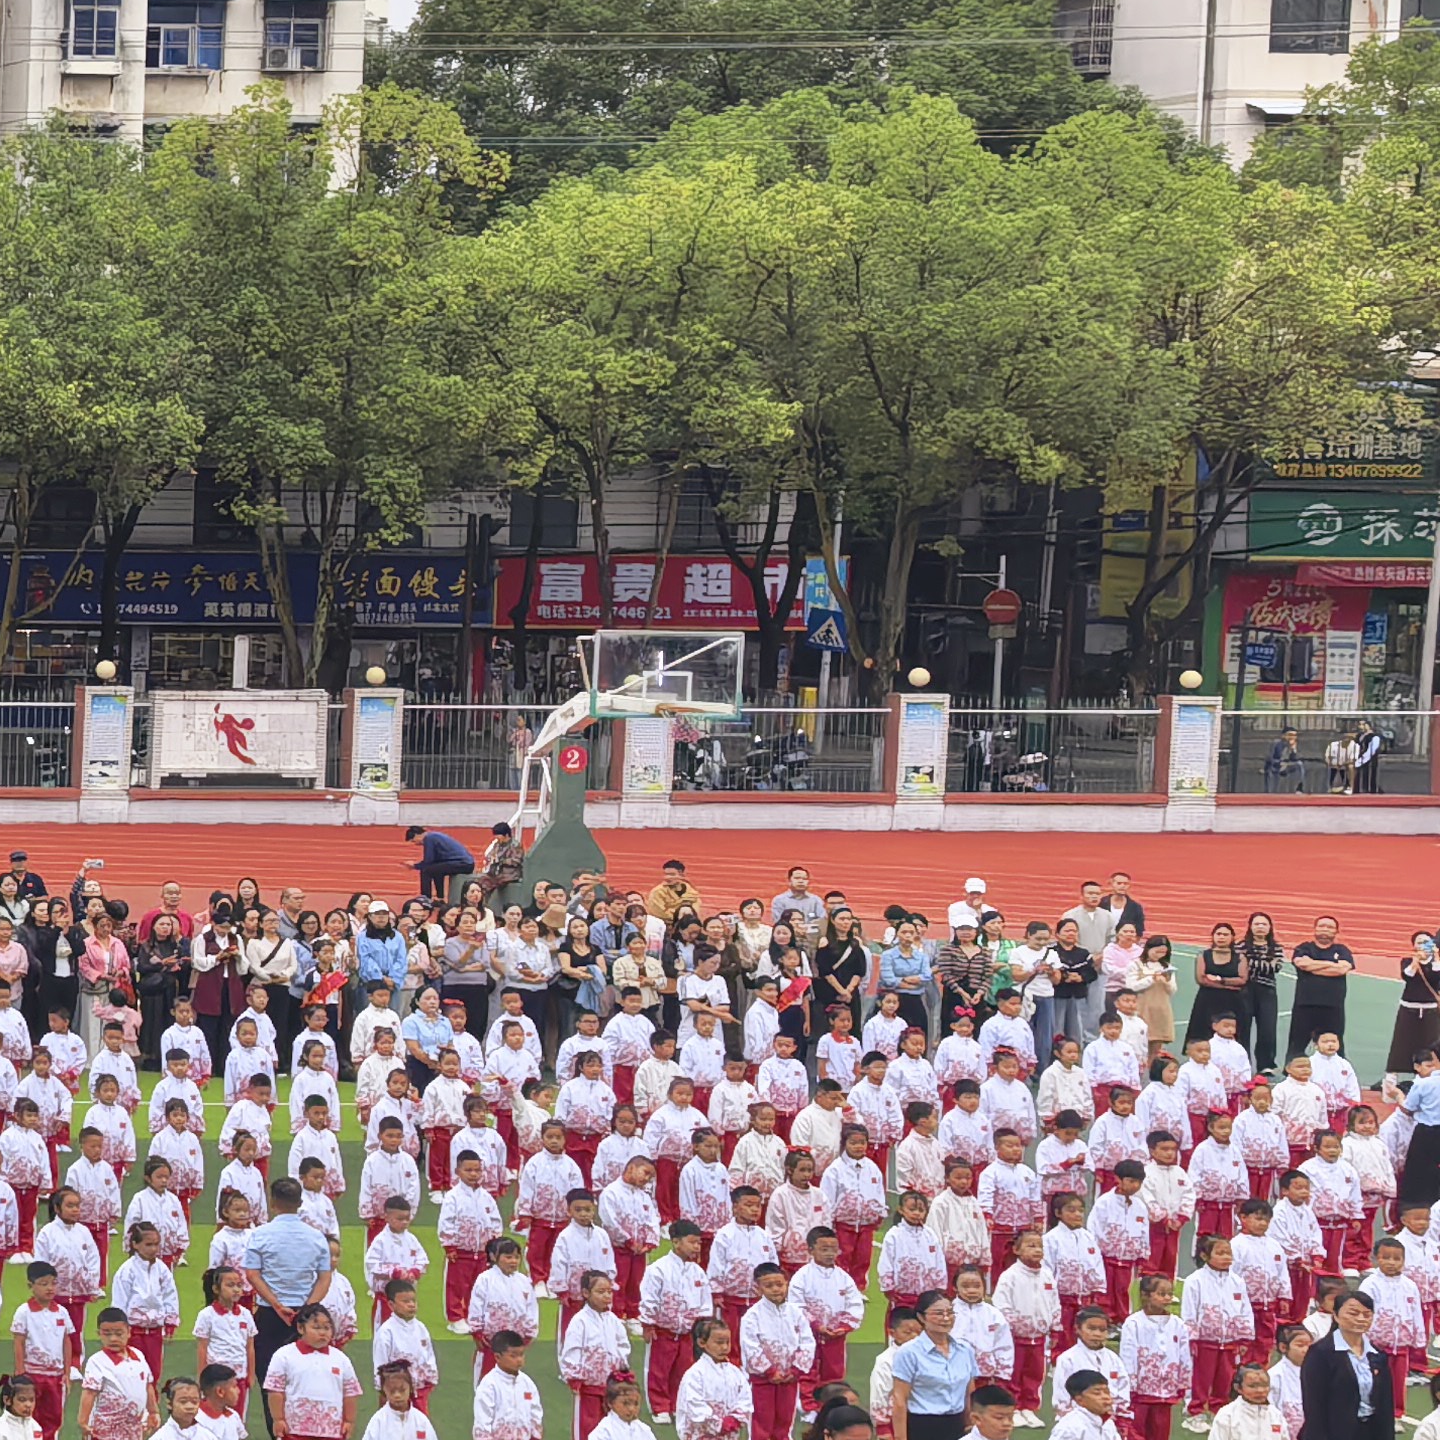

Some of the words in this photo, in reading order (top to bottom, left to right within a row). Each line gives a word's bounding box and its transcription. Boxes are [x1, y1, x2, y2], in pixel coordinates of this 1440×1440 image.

[539, 562, 806, 610] 富贵超市
[537, 605, 672, 620] 电话:134744621
[566, 749, 580, 769] 2
